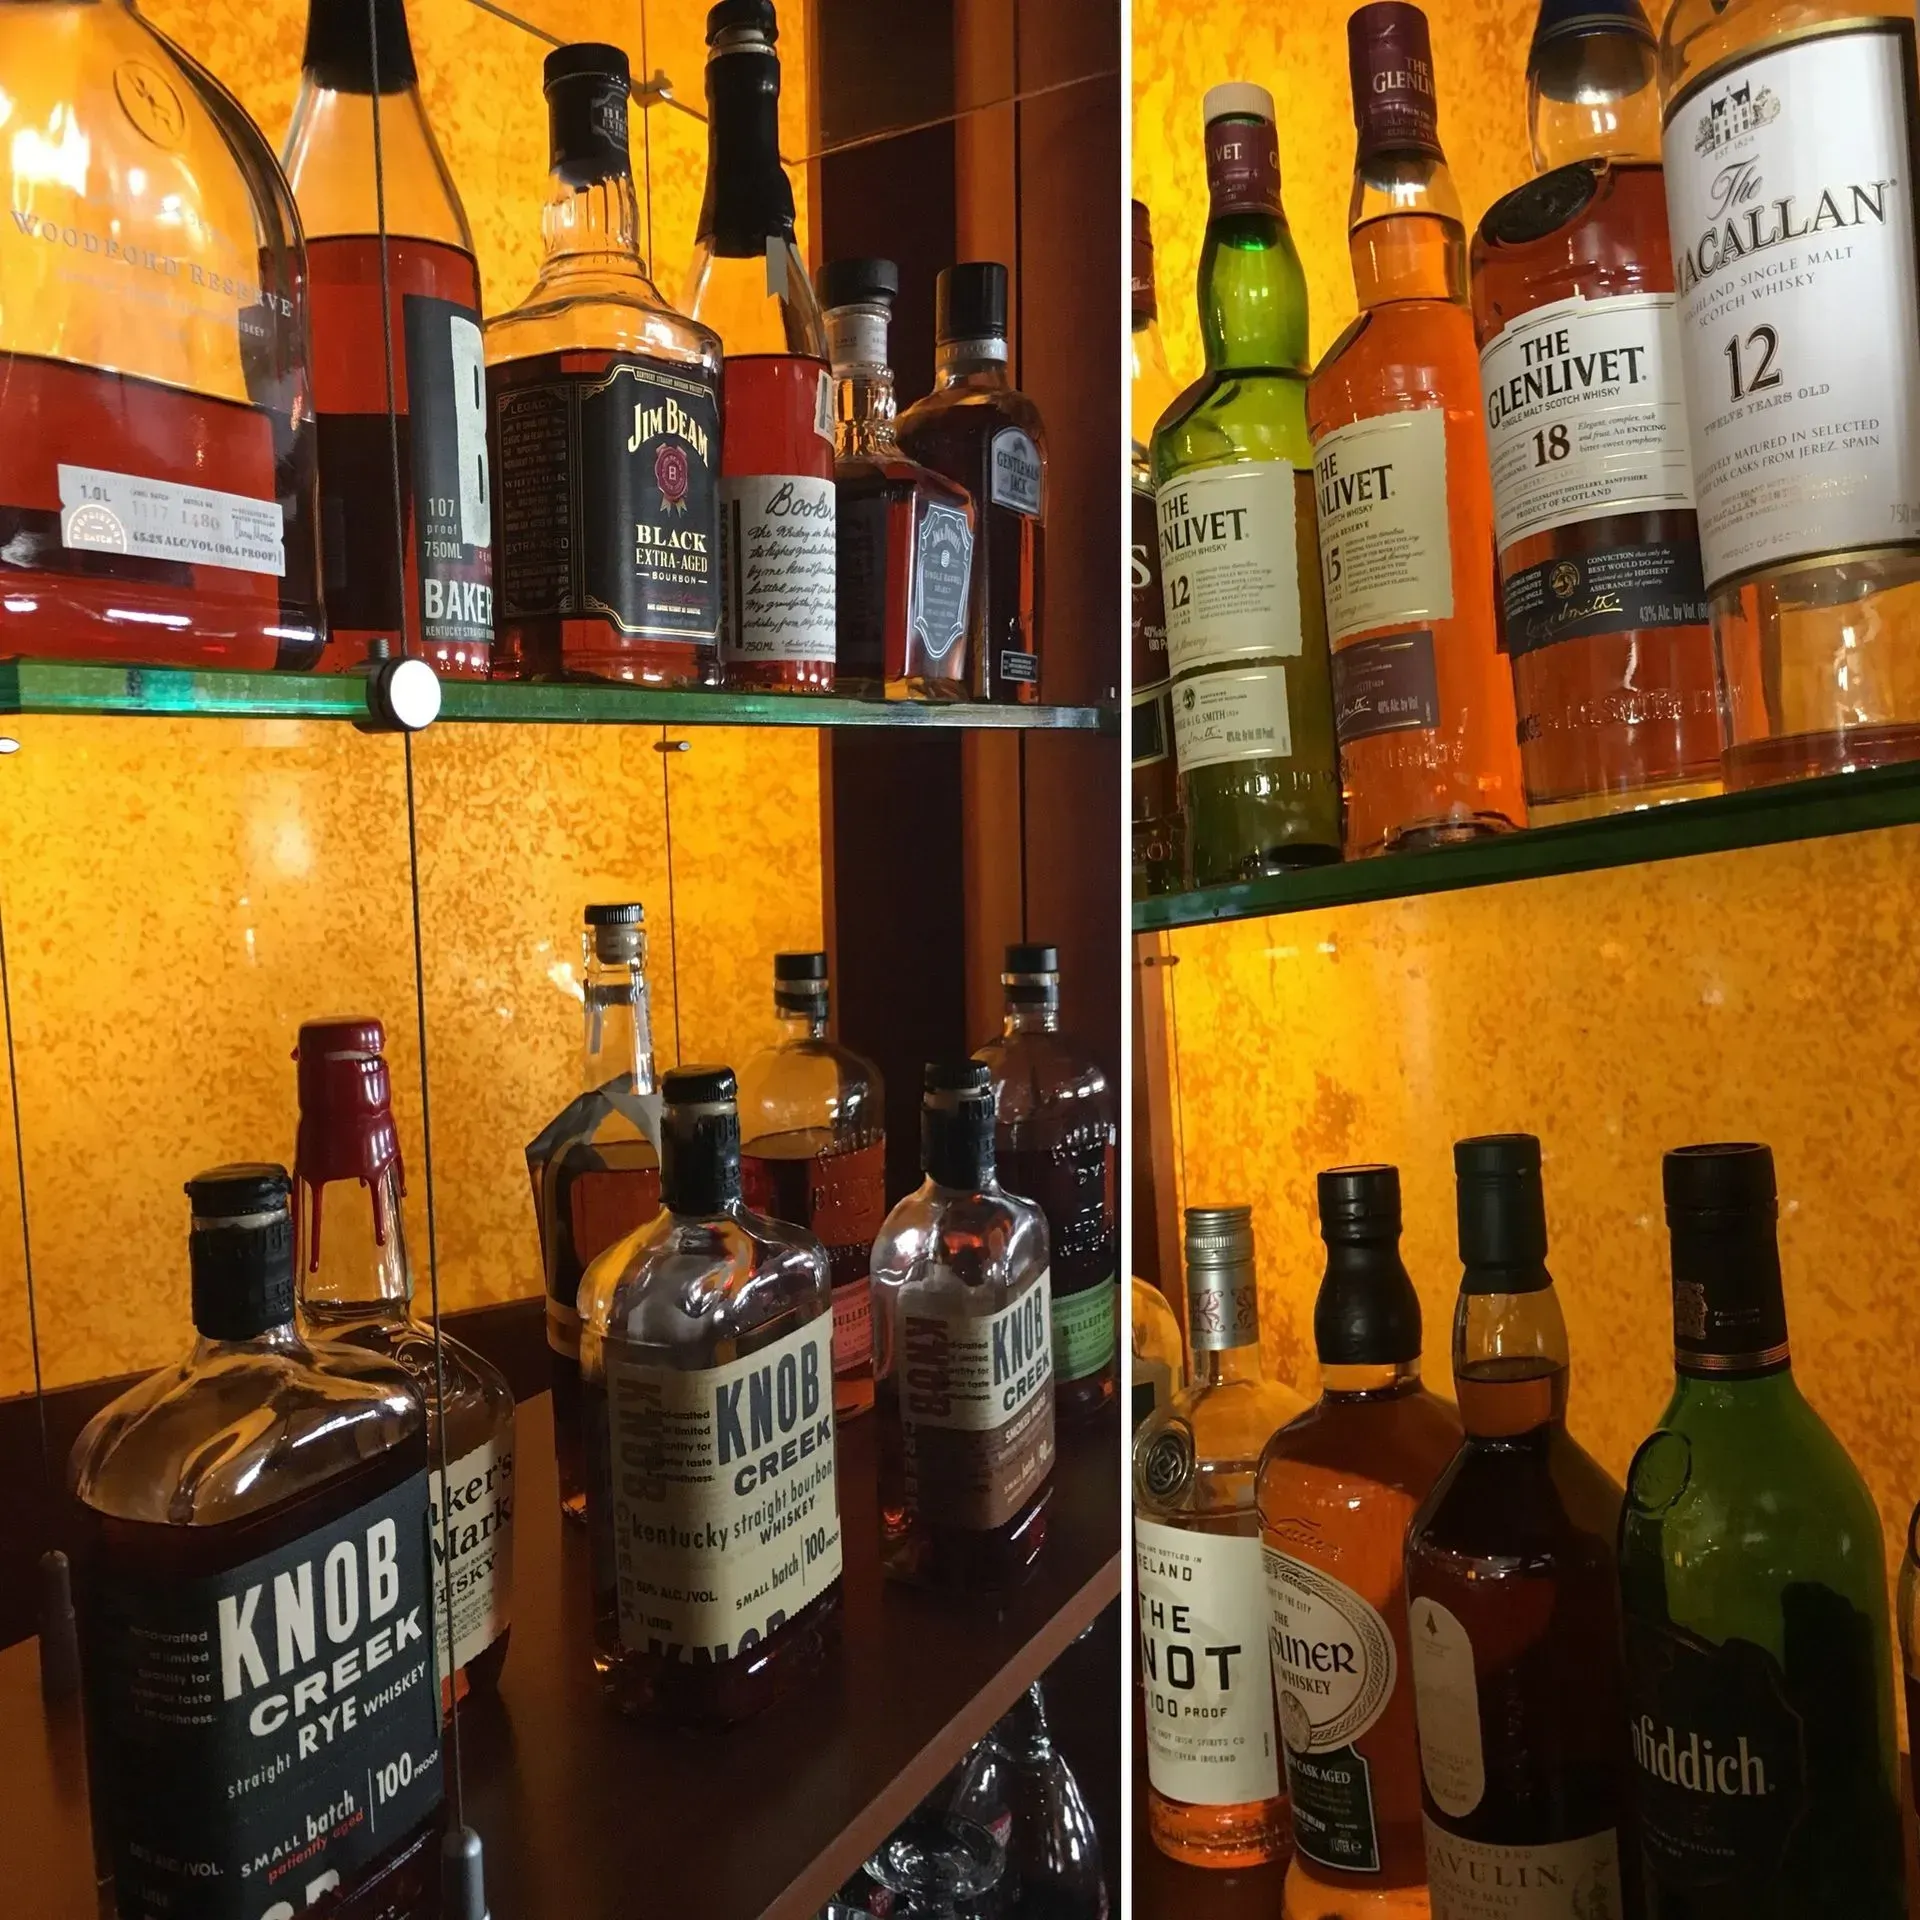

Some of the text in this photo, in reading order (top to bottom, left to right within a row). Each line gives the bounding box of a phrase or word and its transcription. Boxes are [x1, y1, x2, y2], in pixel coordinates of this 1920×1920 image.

[1707, 153, 1763, 221] The
[11, 210, 292, 317] WOODFORD RESERVE
[1740, 257, 1798, 287] SINGLE
[1807, 246, 1854, 265] MALT
[1698, 271, 1816, 328] SCOTCH WHISKY
[1520, 329, 1571, 367] THE
[1722, 321, 1783, 403] 12
[1488, 346, 1645, 430] GLENLIVET
[1501, 386, 1621, 431] SINGLE MALT SCOTCH WHISKY
[1704, 383, 1830, 436] TWELVE YEARS OLD
[627, 403, 664, 453] JIM
[665, 396, 709, 468] BEAM
[1532, 423, 1571, 468] 18
[1627, 423, 1667, 434] ENTICING
[1734, 418, 1880, 461] MATURED IN SELECTED
[1730, 461, 1760, 479] CASKS
[1762, 448, 1795, 467] FROM
[1842, 433, 1880, 450] SPAIN
[668, 465, 677, 482] B
[429, 497, 455, 517] 107
[1161, 493, 1189, 524] THE
[1346, 503, 1374, 518] WHISKY
[1516, 487, 1612, 521] PRODUCT OF SCOTLAND
[426, 523, 457, 536] proof
[636, 524, 707, 553] BLACK
[1340, 520, 1370, 536] RESERVE
[424, 541, 463, 559] 750ML
[636, 547, 708, 573] EXTRA-AGED
[1198, 543, 1227, 556] WHISKY
[1327, 545, 1342, 585] 15
[1587, 551, 1635, 565] CONVICTION
[652, 571, 696, 584] BOURBON
[1588, 564, 1606, 575] BEST
[1607, 560, 1638, 573] WOULD
[1638, 559, 1651, 567] DO
[1634, 567, 1670, 578] HIGHEST
[1169, 575, 1191, 610] 12
[1590, 580, 1634, 593] ASSURANCE
[1639, 605, 1657, 623] 43%
[1657, 604, 1672, 620] Alc.
[1673, 604, 1682, 621] by
[426, 625, 462, 638] KENTUCKY
[1201, 709, 1226, 723] SMITH
[992, 1286, 1043, 1386] KNOB
[1003, 1348, 1050, 1411] CREEK
[716, 1340, 819, 1466] KNOB
[686, 1457, 712, 1467] taste
[697, 1441, 711, 1451] for
[734, 1414, 833, 1497] CREEK
[631, 1459, 832, 1551] kentucky straight bourbon
[759, 1494, 816, 1546] WHISKEY
[736, 1581, 771, 1611] SMALL
[772, 1554, 799, 1590] batch
[804, 1526, 826, 1565] 100
[1193, 1556, 1202, 1564] IN
[217, 1517, 400, 1701] KNOB
[1140, 1592, 1191, 1634] THE
[1274, 1610, 1289, 1628] THE
[191, 1673, 212, 1684] for
[249, 1606, 423, 1737] CREEK
[1281, 1671, 1331, 1696] WHISKEY
[179, 1693, 212, 1705] taste
[1150, 1691, 1228, 1718] 100 PROOF
[227, 1660, 427, 1800] straight RYE WHISKEY
[1297, 1761, 1351, 1785] CASK AGED
[240, 1749, 439, 1879] SMALL batch 100 PROOF
[268, 1809, 365, 1886] patiently aged
